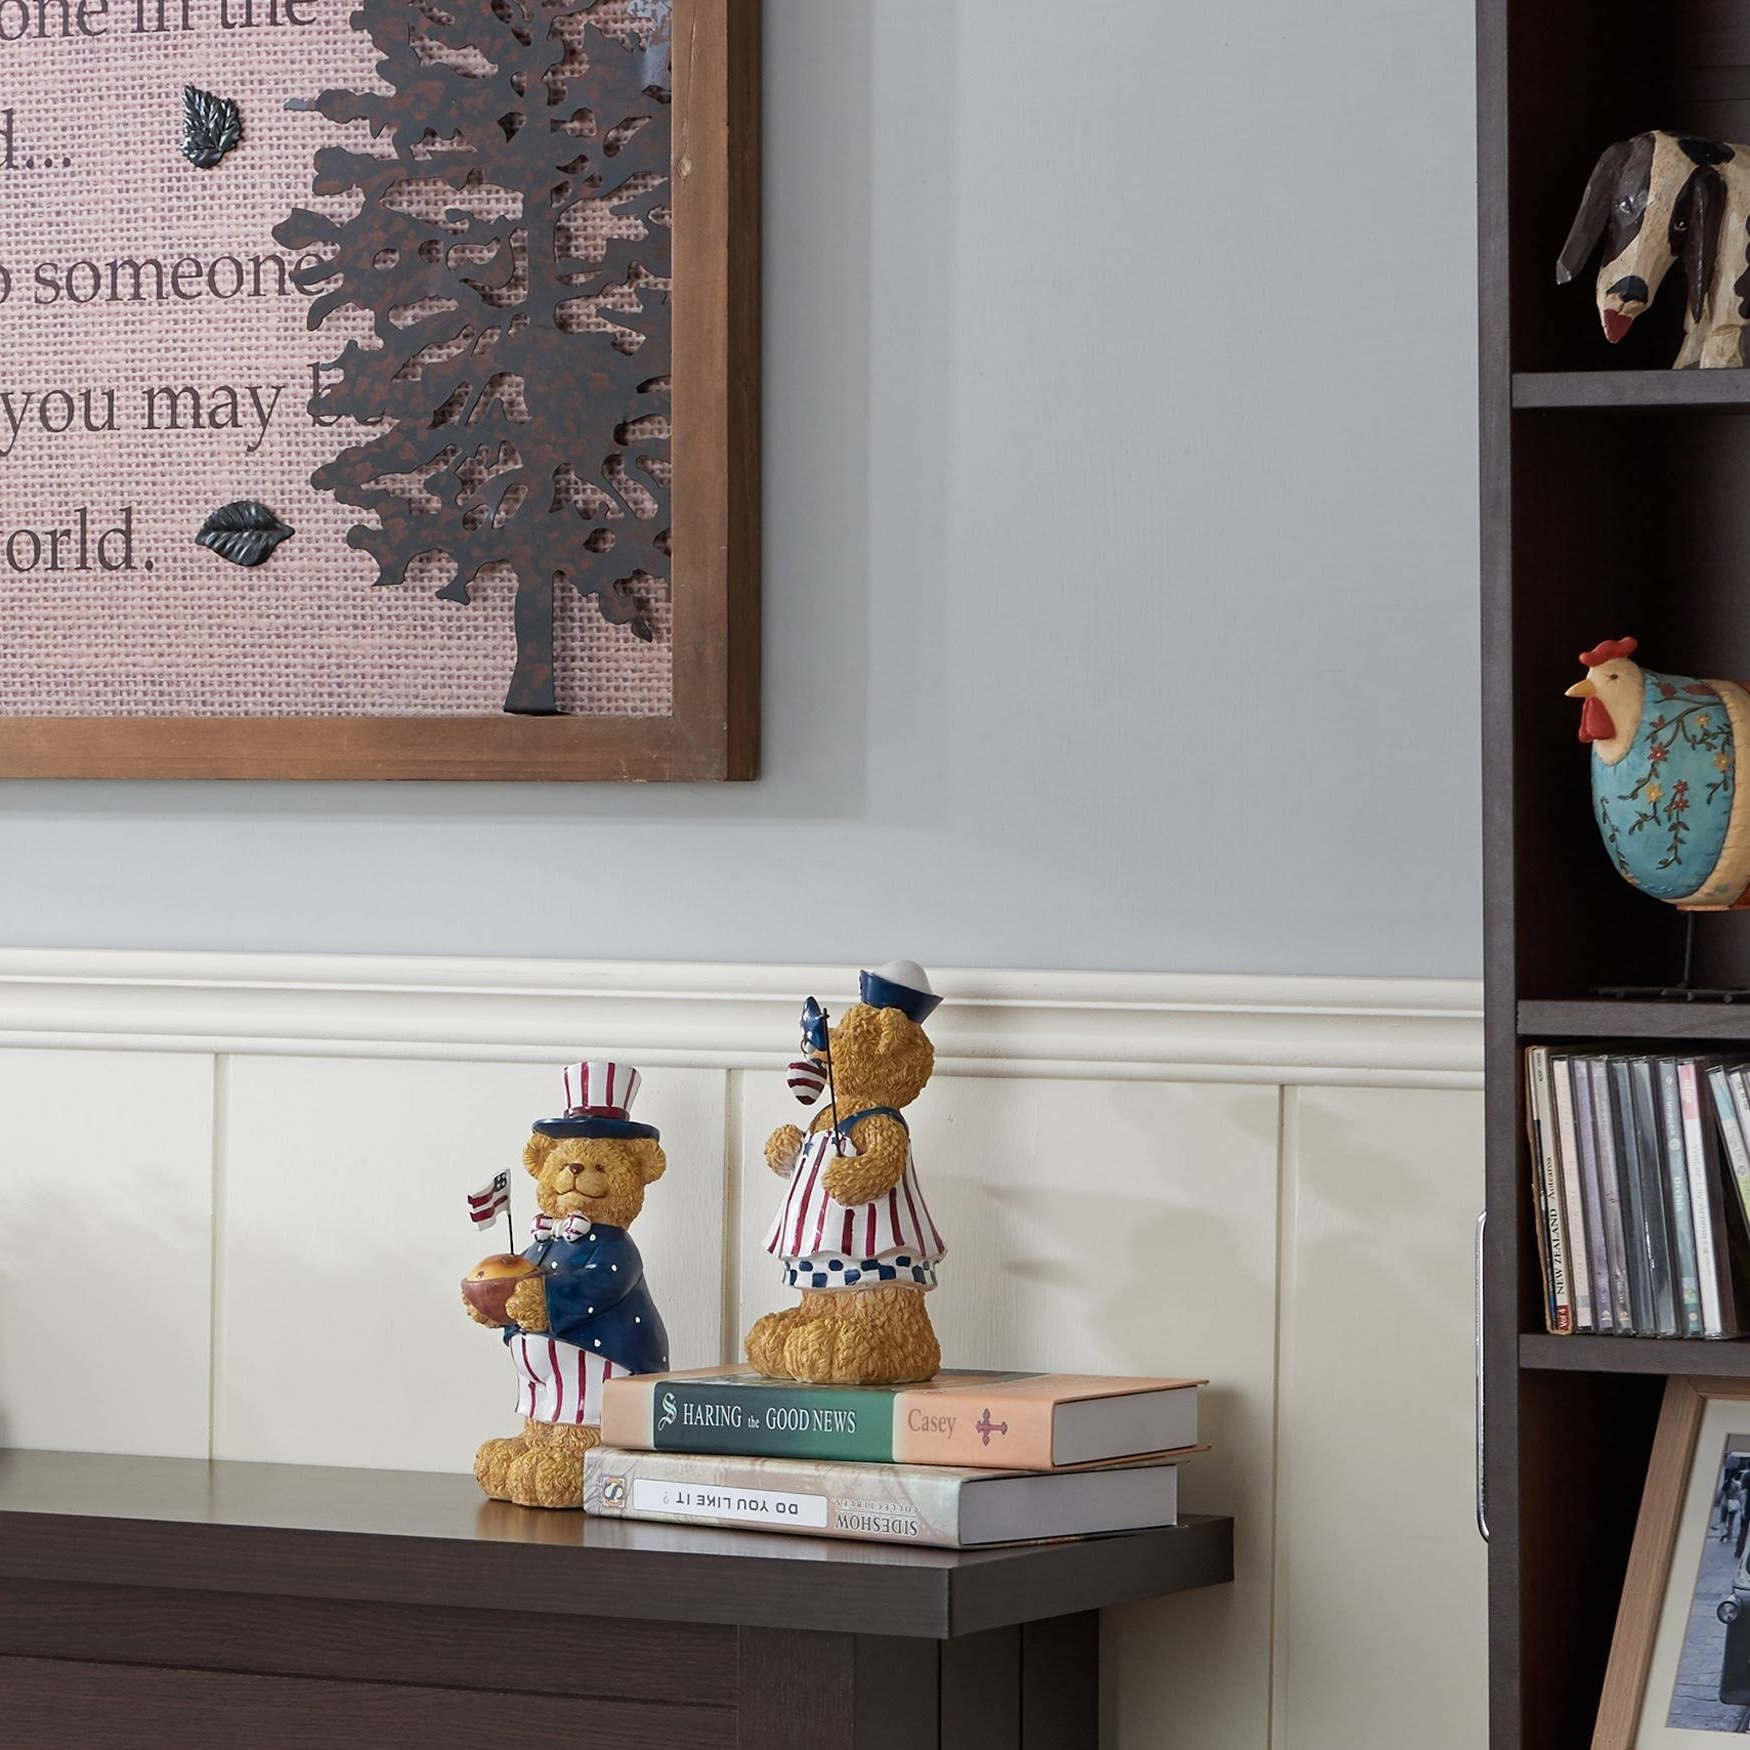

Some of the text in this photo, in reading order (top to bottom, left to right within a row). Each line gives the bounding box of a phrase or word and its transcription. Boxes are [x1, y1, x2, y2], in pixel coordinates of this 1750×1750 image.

[33, 252, 328, 305] someone
[141, 383, 287, 453] may
[1549, 1209, 1563, 1264] ZEALAND
[1554, 1268, 1565, 1295] NEW
[747, 1416, 761, 1430] the
[766, 1407, 810, 1432] GOOD
[813, 1410, 857, 1434] NEWS
[907, 1408, 958, 1440] Casey
[675, 1491, 691, 1506] IT
[697, 1494, 732, 1510] LIKE
[736, 1497, 770, 1514] YOU
[775, 1501, 799, 1516] DO
[834, 1512, 919, 1537] SIDESHOW
